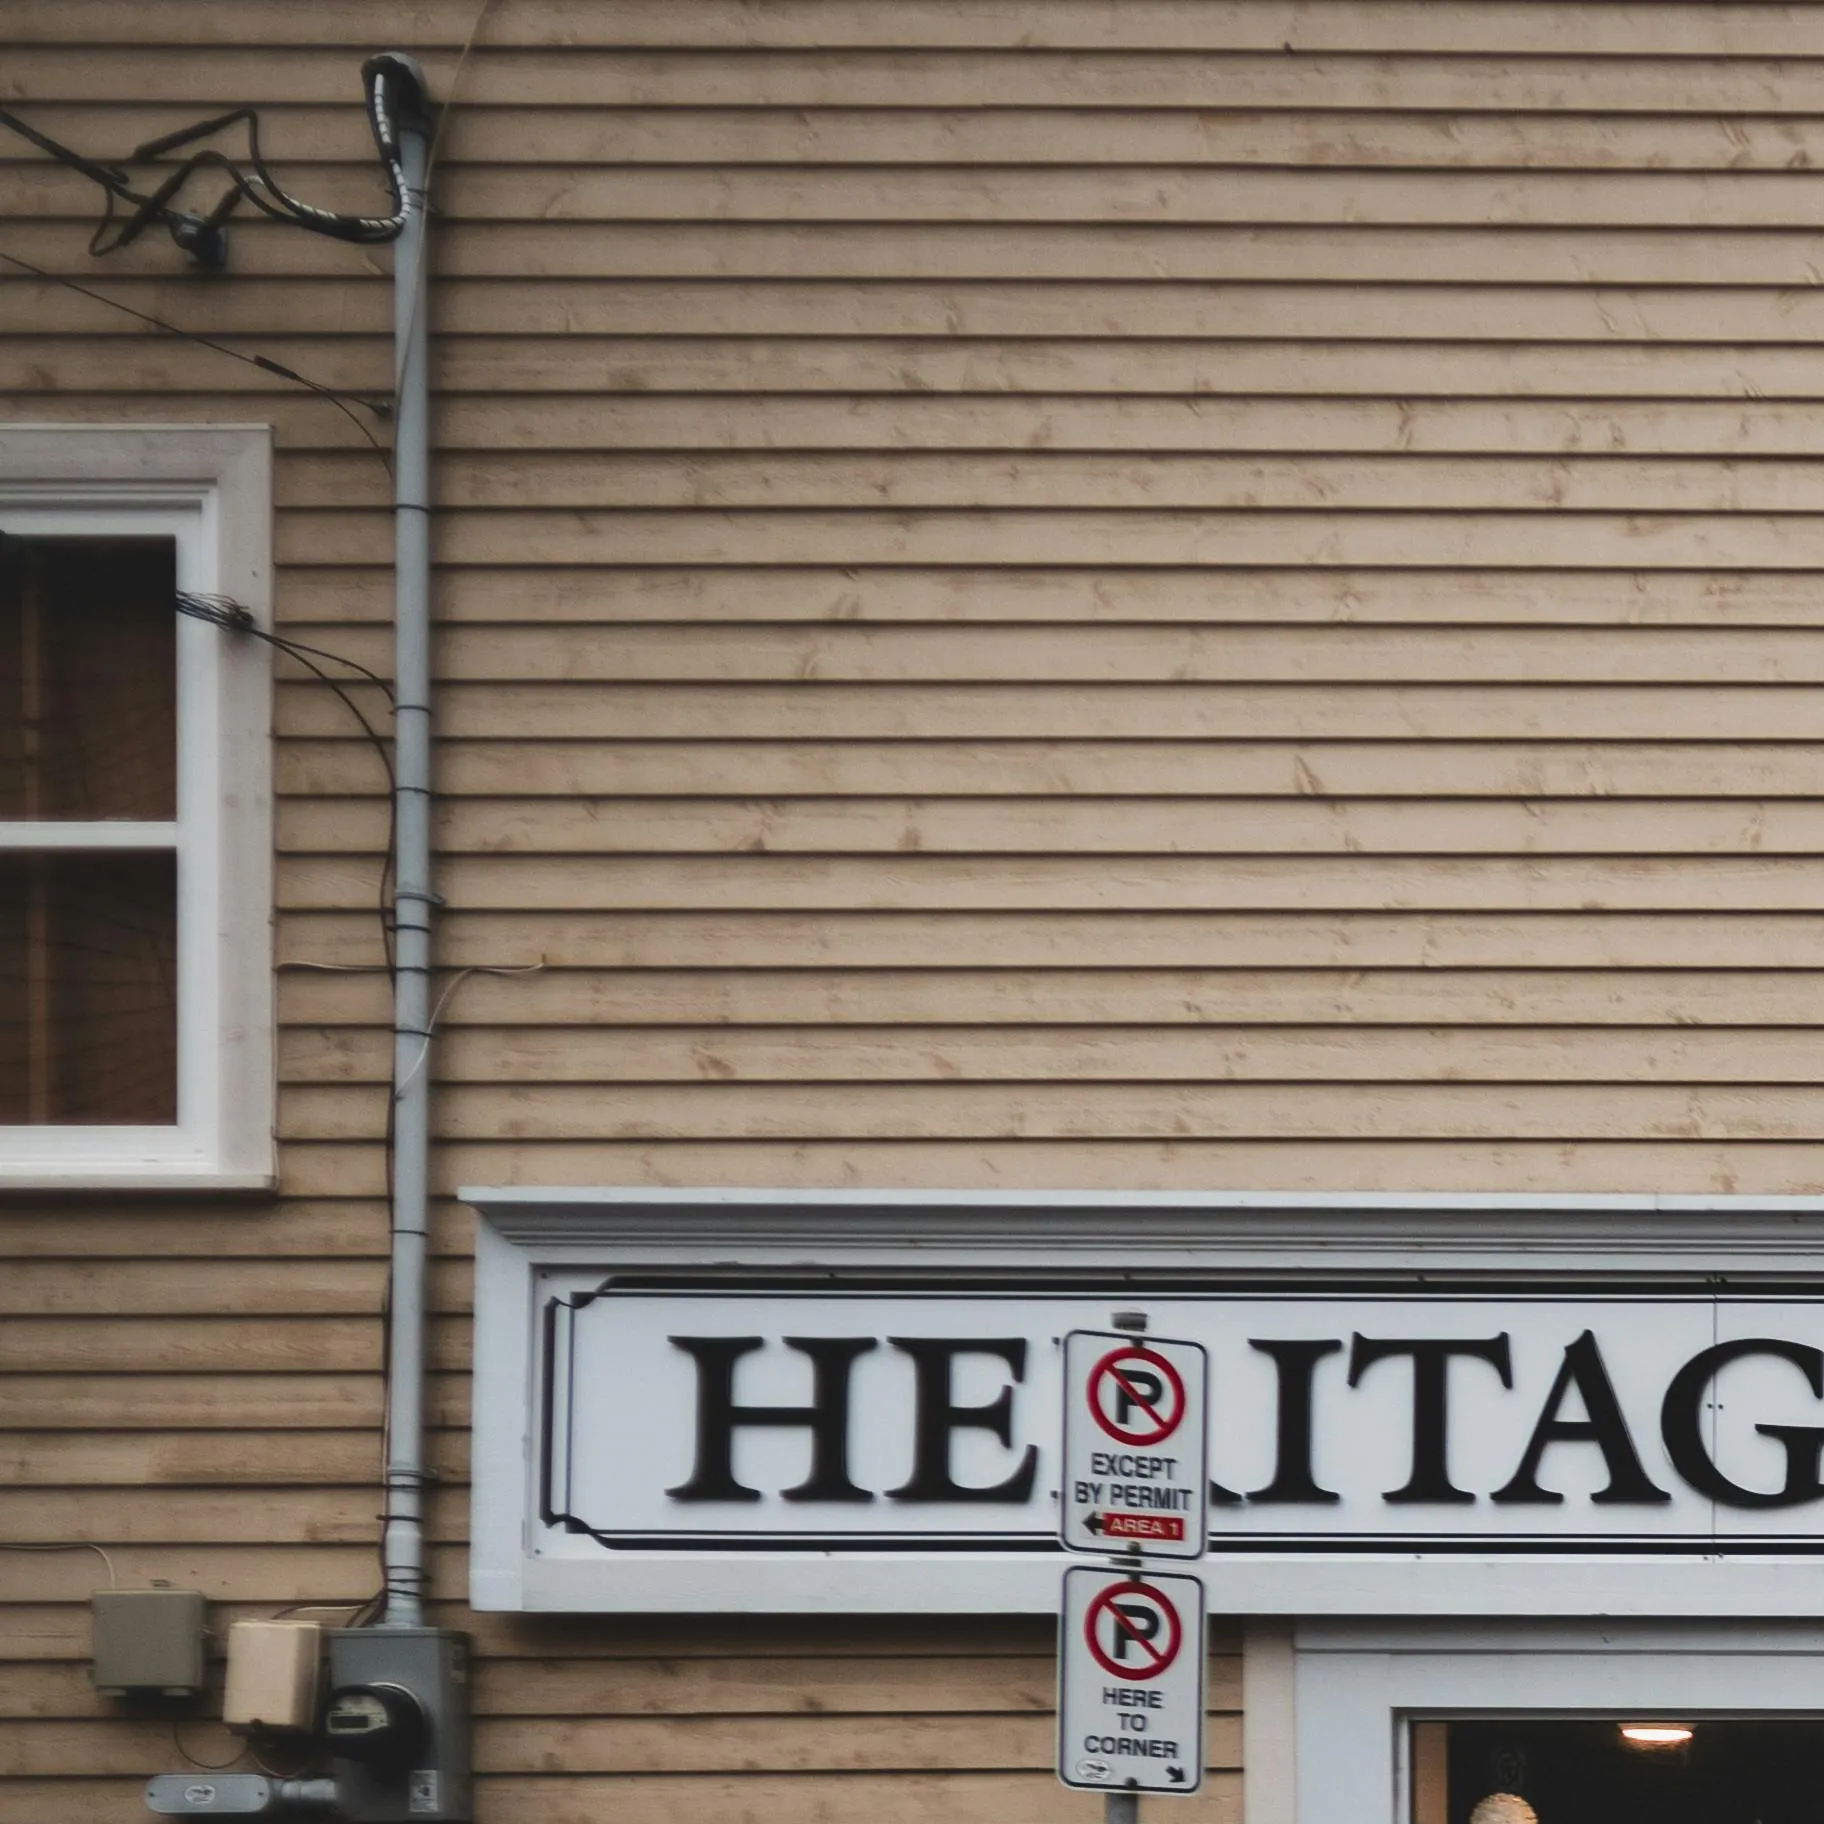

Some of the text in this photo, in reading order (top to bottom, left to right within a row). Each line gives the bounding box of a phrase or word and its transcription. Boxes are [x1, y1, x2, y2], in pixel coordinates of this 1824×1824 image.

[1092, 1453, 1177, 1480] EXCEPT
[1074, 1480, 1194, 1511] BY PERMIT
[1110, 1518, 1179, 1535] AREA 1
[1102, 1687, 1164, 1709] HERE
[1117, 1712, 1148, 1732] TO
[1083, 1735, 1179, 1758] CORNER
